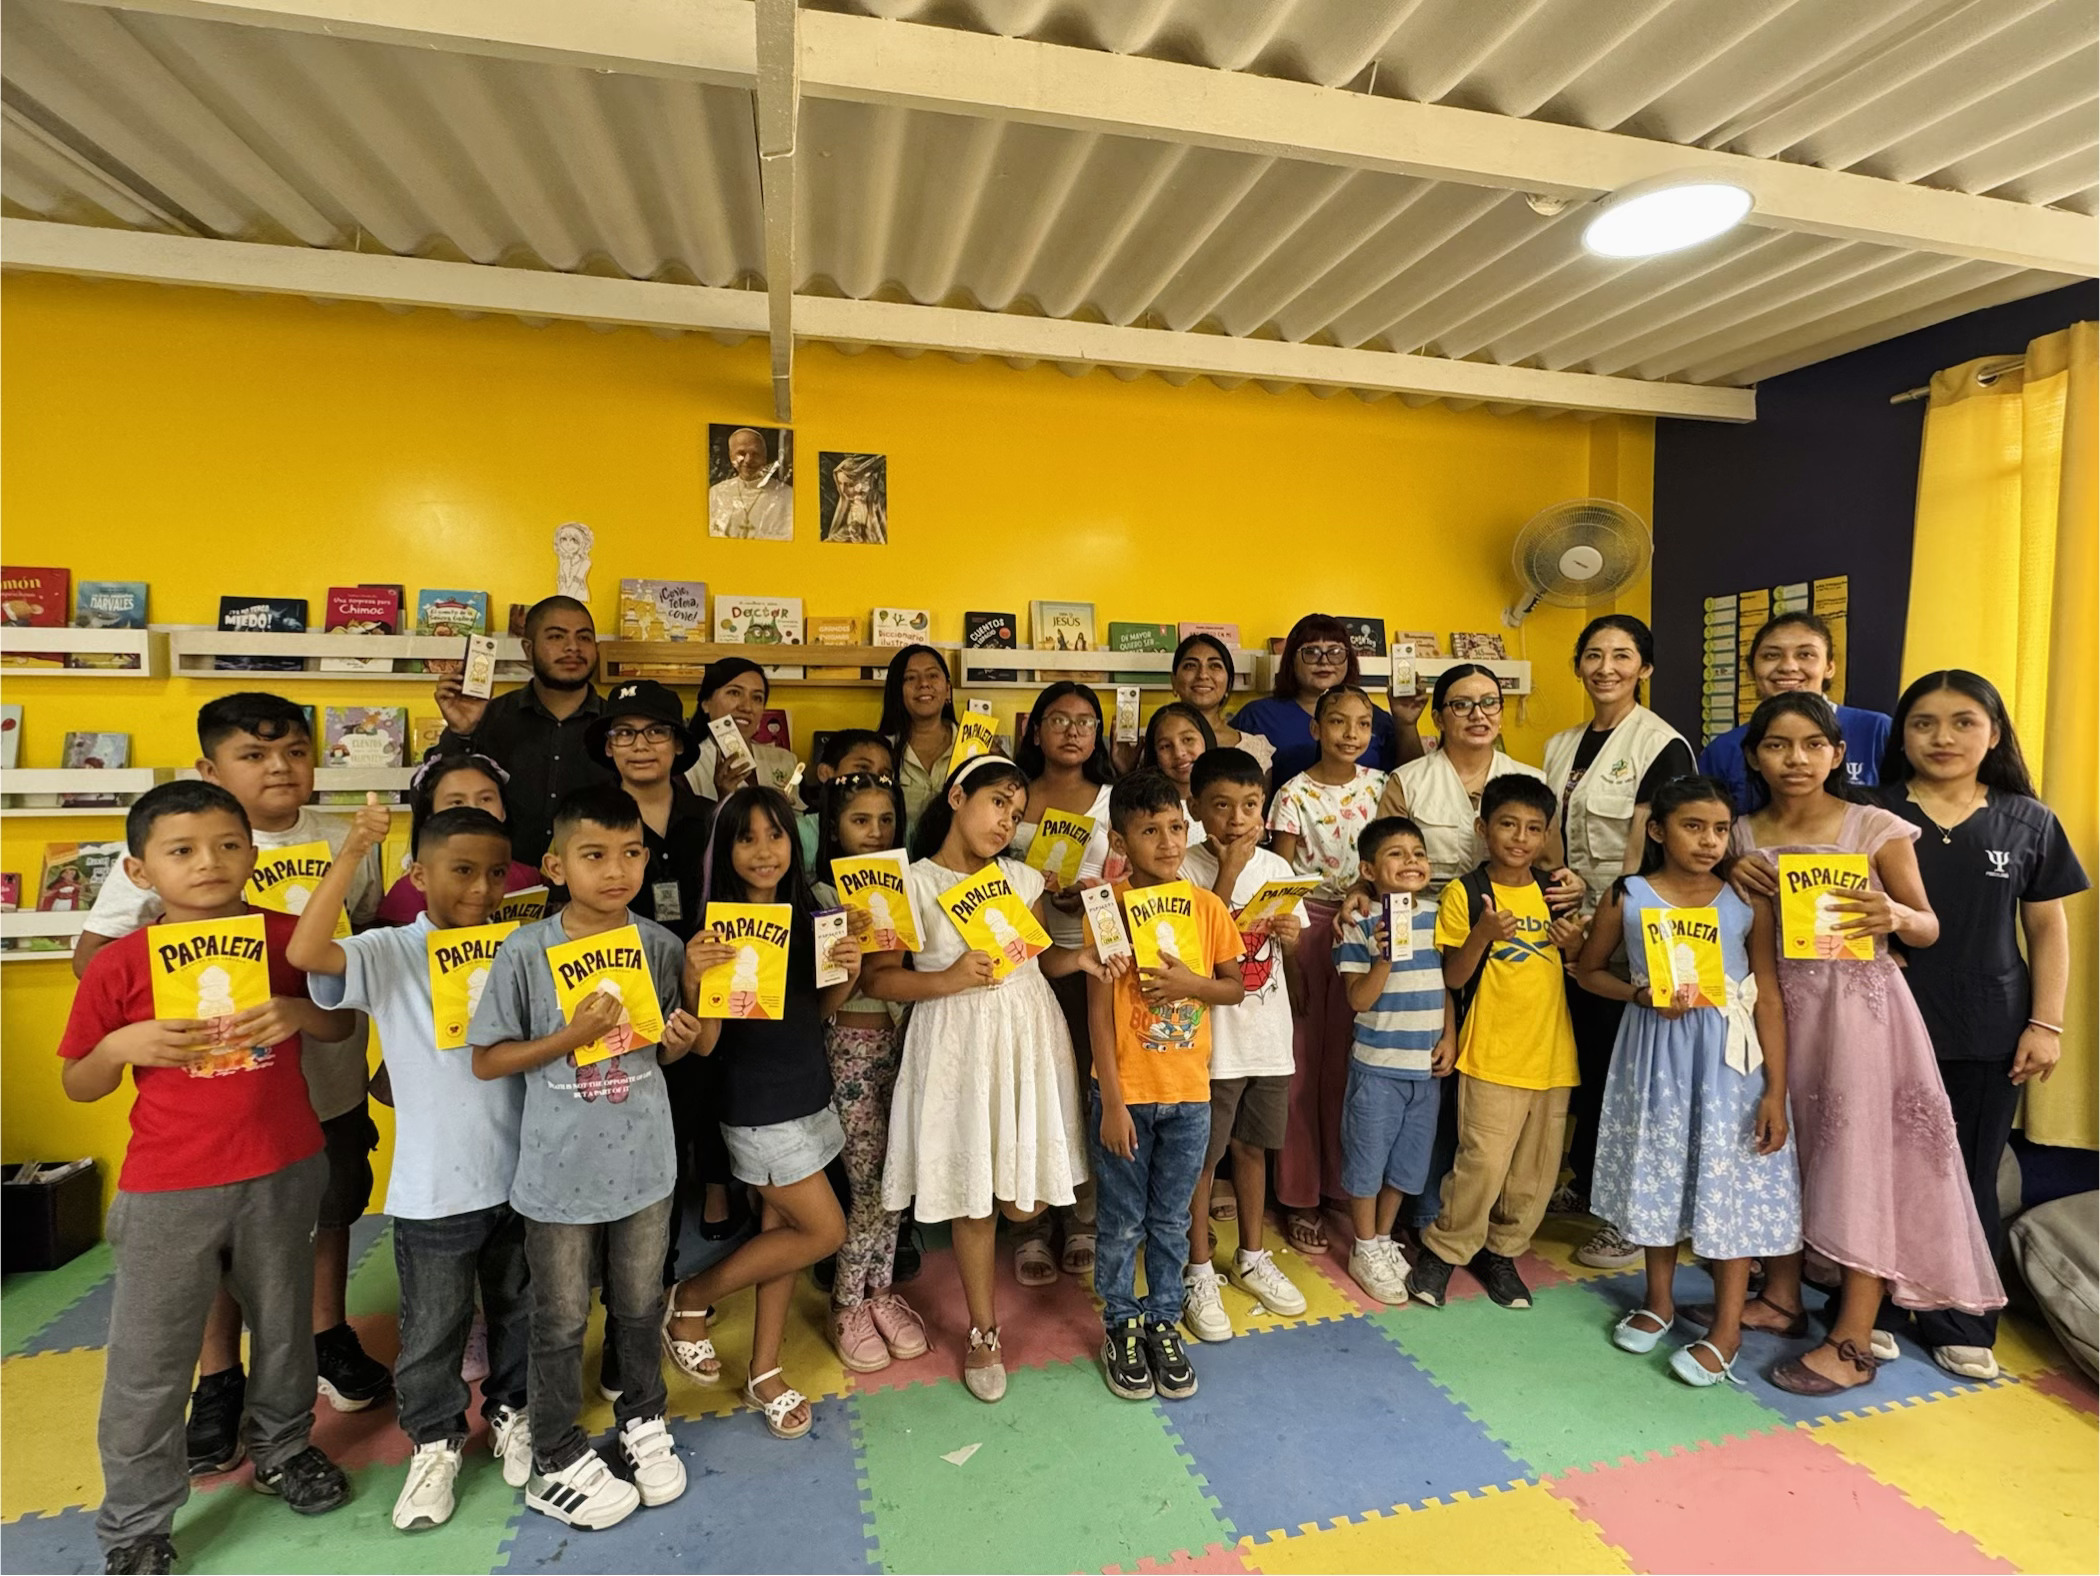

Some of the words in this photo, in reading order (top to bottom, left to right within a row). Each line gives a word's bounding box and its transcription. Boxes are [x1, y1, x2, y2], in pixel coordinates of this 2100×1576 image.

[225, 612, 273, 629] MIEDO!
[339, 603, 384, 616] Chimoc
[878, 630, 924, 642] Diccionario
[970, 618, 1005, 641] CUENTOS
[1130, 631, 1152, 641] MAYOR
[618, 685, 637, 700] M
[1042, 820, 1091, 846] PAPALETA
[840, 869, 904, 896] PAPALETA
[1786, 867, 1868, 894] PAPALETA
[951, 879, 1012, 924] PAPALETA
[1130, 897, 1191, 928] PAPALETA
[712, 917, 789, 948] PAPALETA
[1647, 919, 1718, 944] PAPALETA
[158, 935, 264, 974] PAPALETA
[435, 940, 504, 975] PAPALE
[558, 948, 642, 990] PAPALETA
